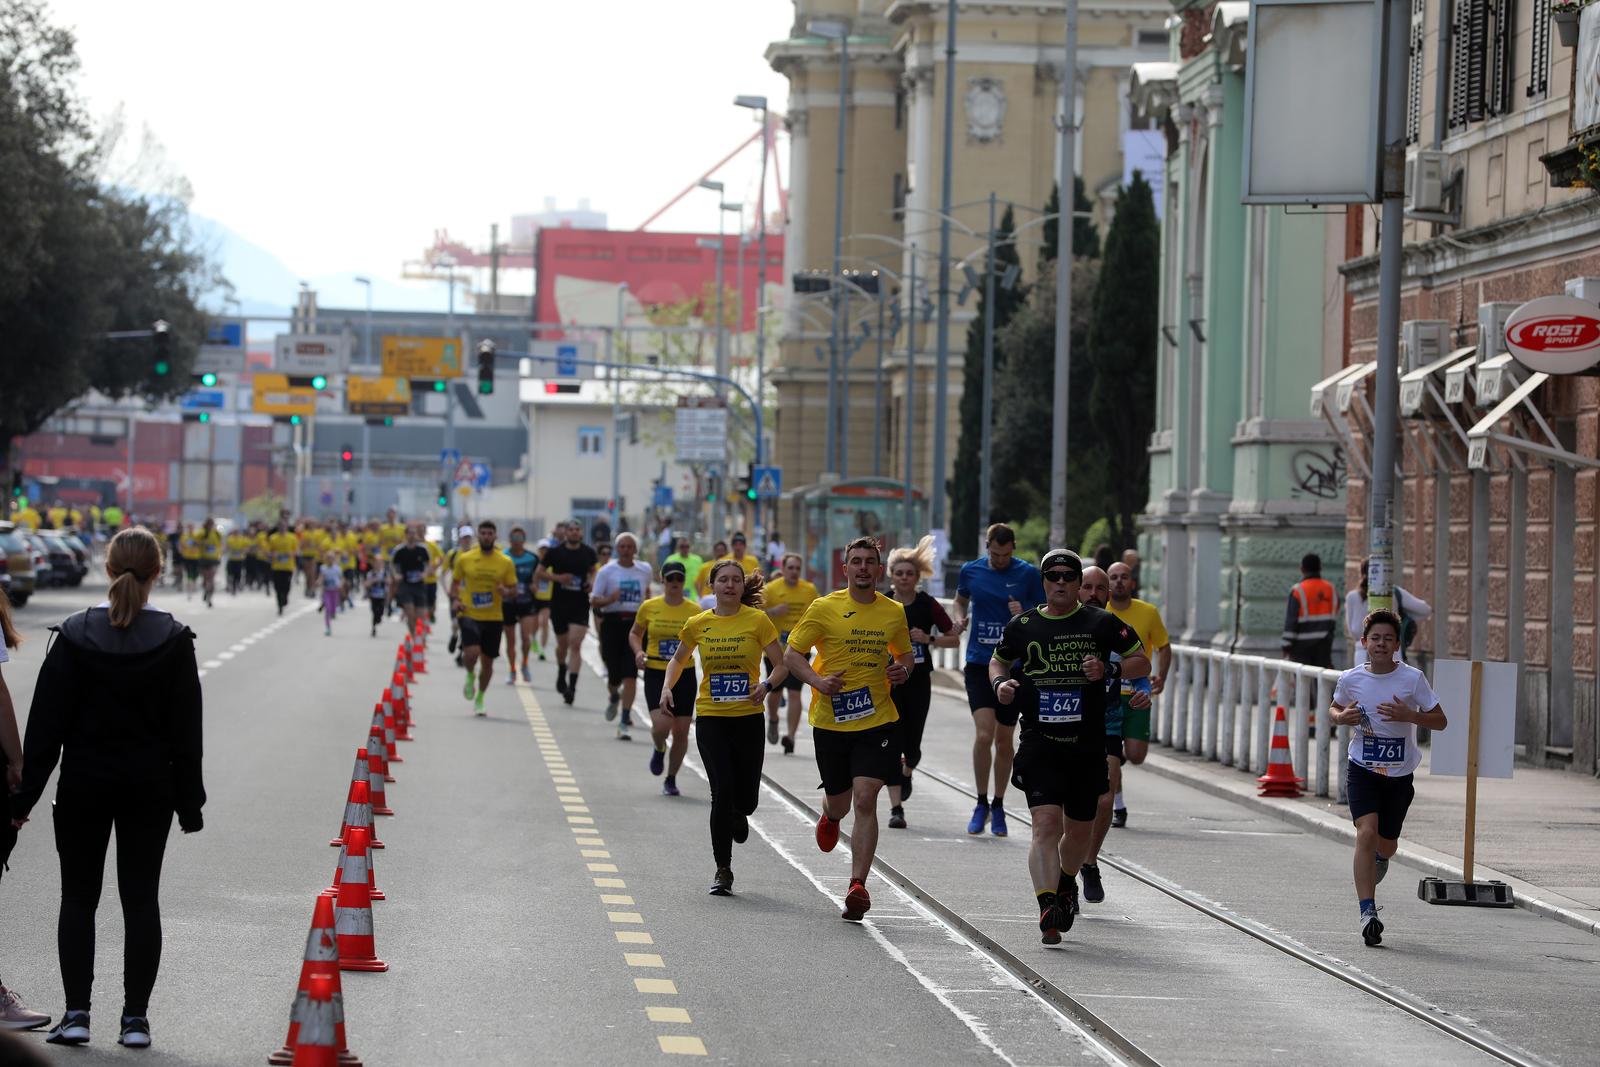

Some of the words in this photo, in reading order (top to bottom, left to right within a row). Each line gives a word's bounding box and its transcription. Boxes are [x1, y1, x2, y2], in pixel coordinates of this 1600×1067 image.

[1532, 324, 1586, 336] ROST
[716, 645, 739, 653] misery!
[1048, 641, 1097, 652] LAPOVAC
[723, 680, 748, 693] 757
[846, 694, 872, 711] 644
[1053, 698, 1080, 712] 647
[1378, 745, 1402, 758] 761
